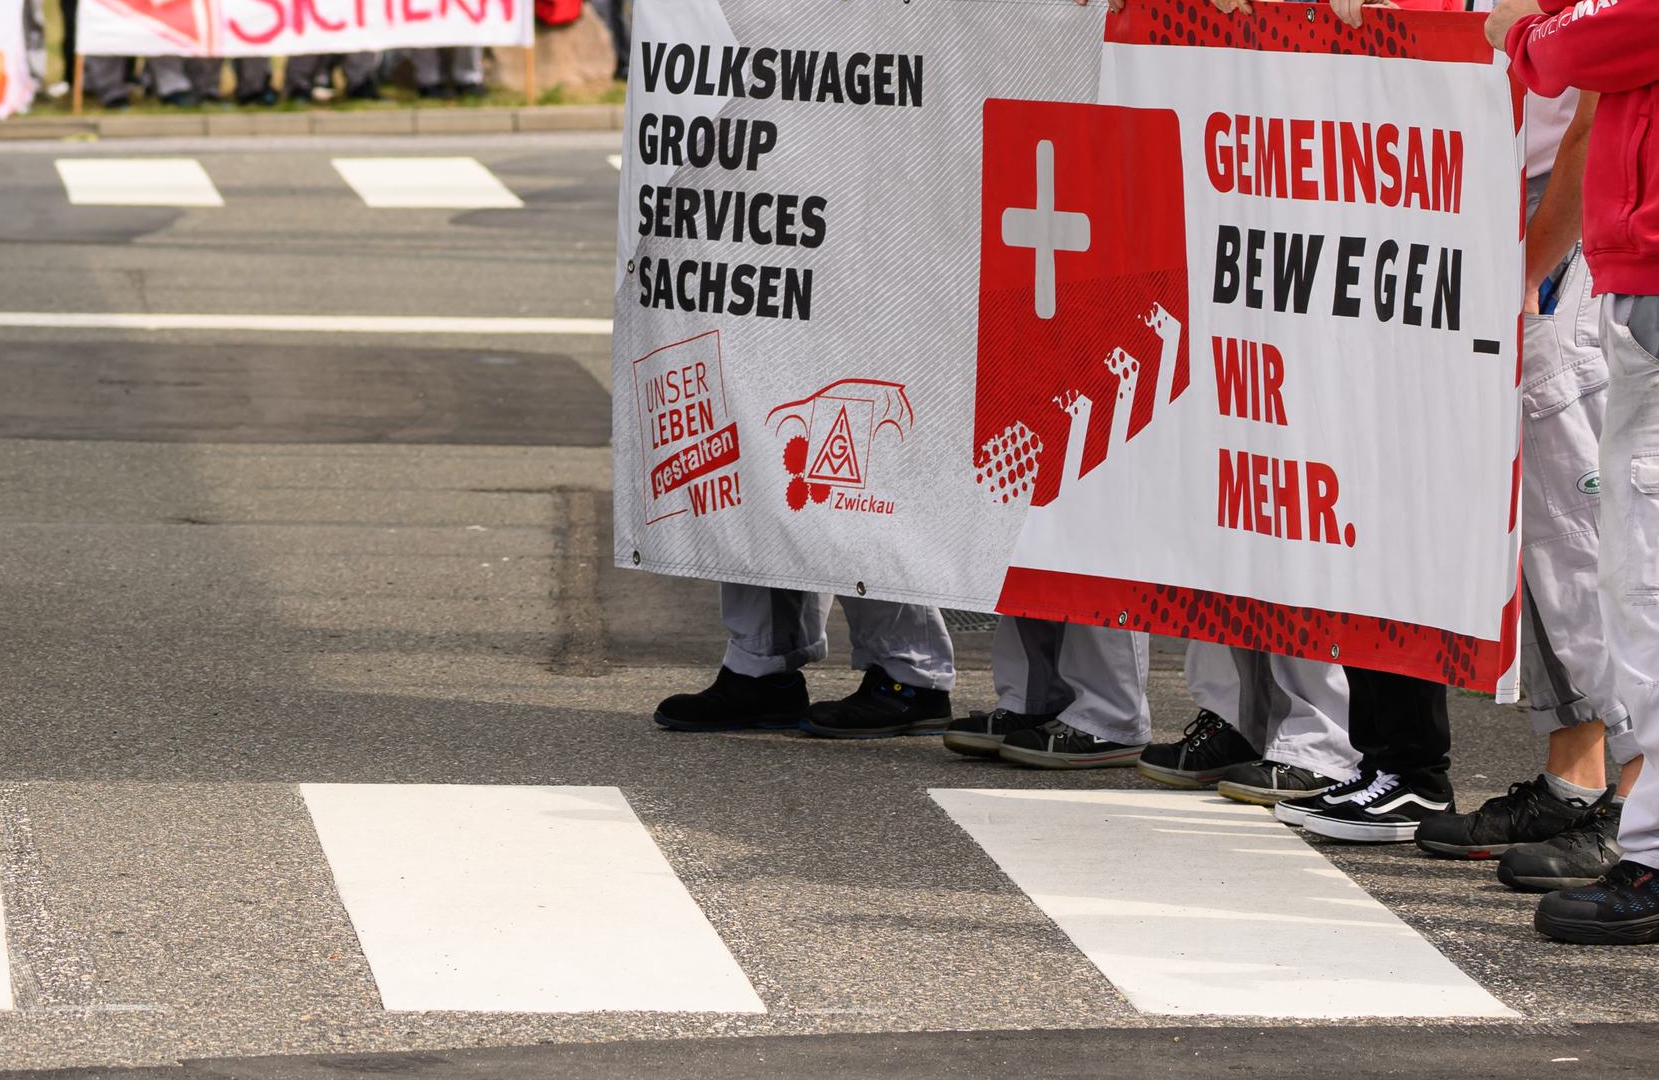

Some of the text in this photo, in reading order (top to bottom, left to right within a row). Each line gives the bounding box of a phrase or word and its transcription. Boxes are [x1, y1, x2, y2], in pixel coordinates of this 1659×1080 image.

[641, 41, 924, 107] VOLKSWAGEN
[638, 112, 779, 171] GROUP
[1203, 111, 1464, 215] GEMEINSAM
[638, 184, 828, 249] SERVICES
[639, 256, 813, 321] SACHSEN
[645, 361, 710, 413] UNSER
[1211, 335, 1289, 427] WIR
[651, 397, 715, 450] LEBEN
[653, 428, 735, 495] gestalten
[686, 471, 742, 518] WIR!
[834, 492, 895, 515] Zwickau
[1217, 448, 1357, 549] MEHR.
